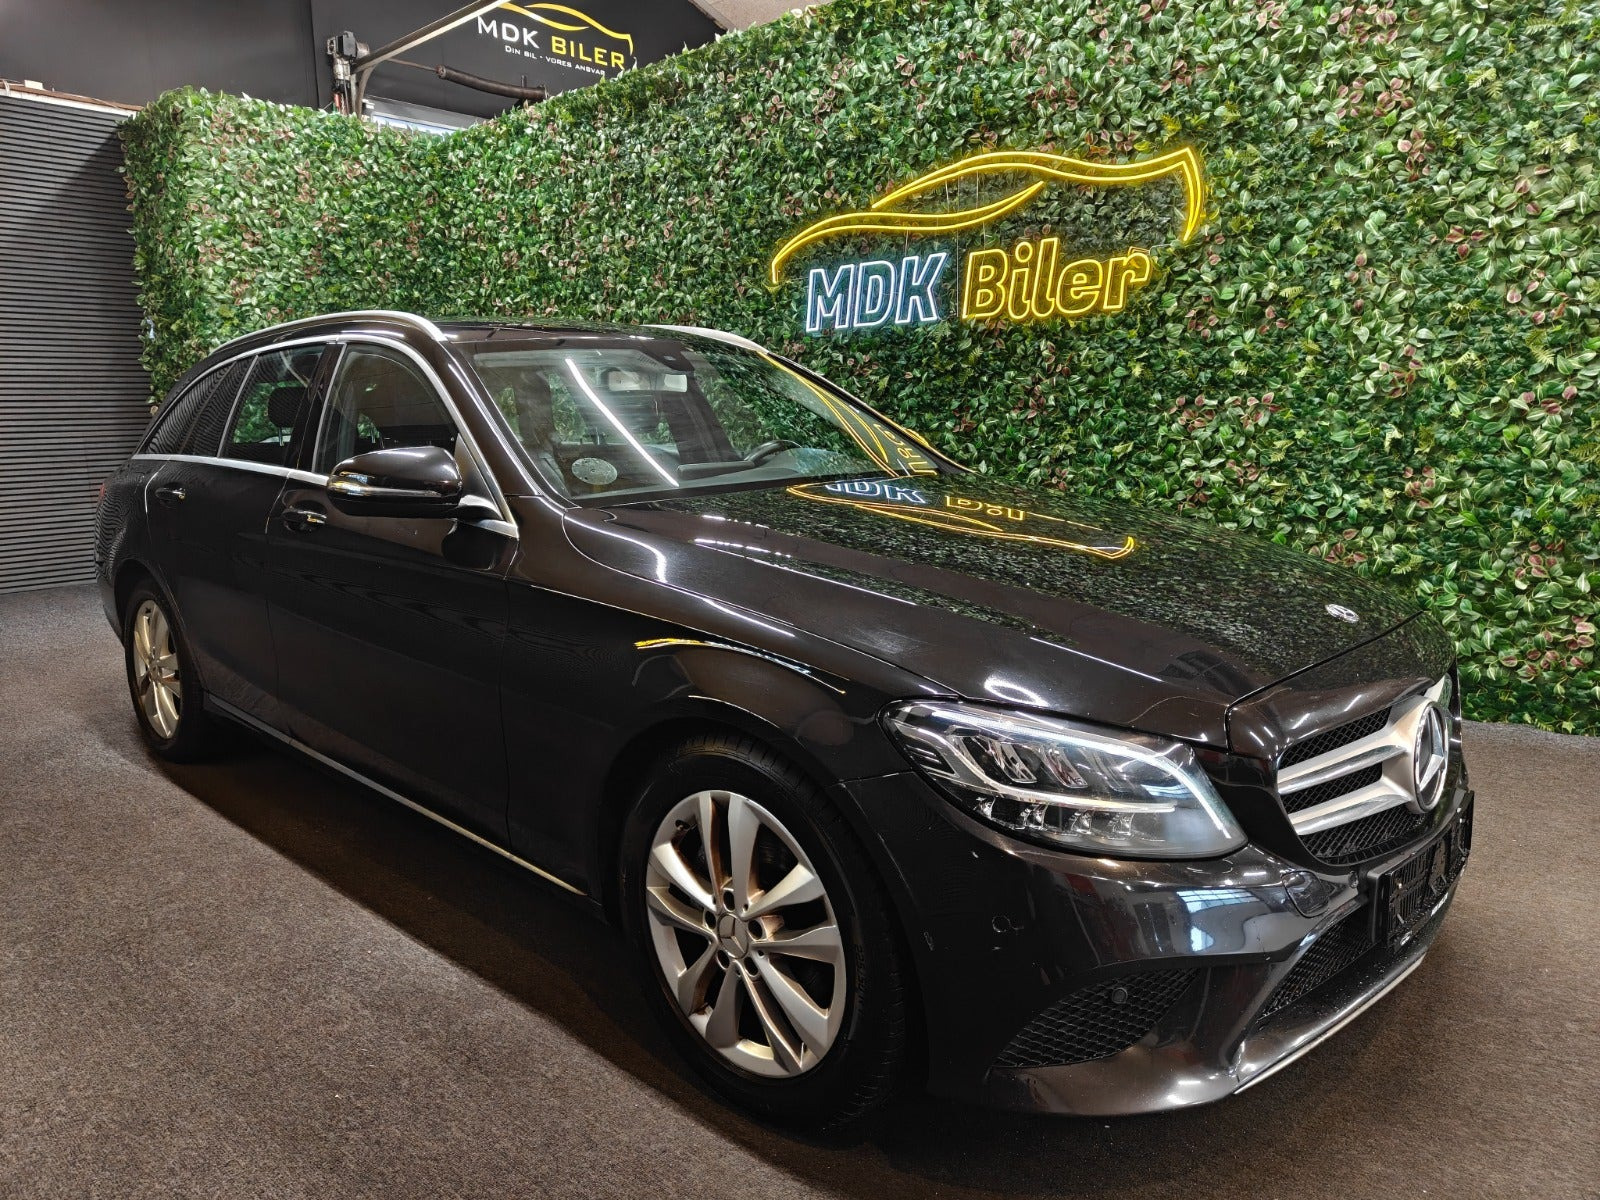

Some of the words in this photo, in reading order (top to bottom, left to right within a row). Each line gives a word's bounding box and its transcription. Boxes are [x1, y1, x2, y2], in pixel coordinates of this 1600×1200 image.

[477, 16, 540, 48] MDK
[551, 36, 625, 69] BILER
[505, 45, 521, 56] DIN
[524, 51, 537, 60] BIL
[545, 57, 572, 69] VORES
[806, 252, 947, 333] MDK
[962, 237, 1152, 320] Biler
